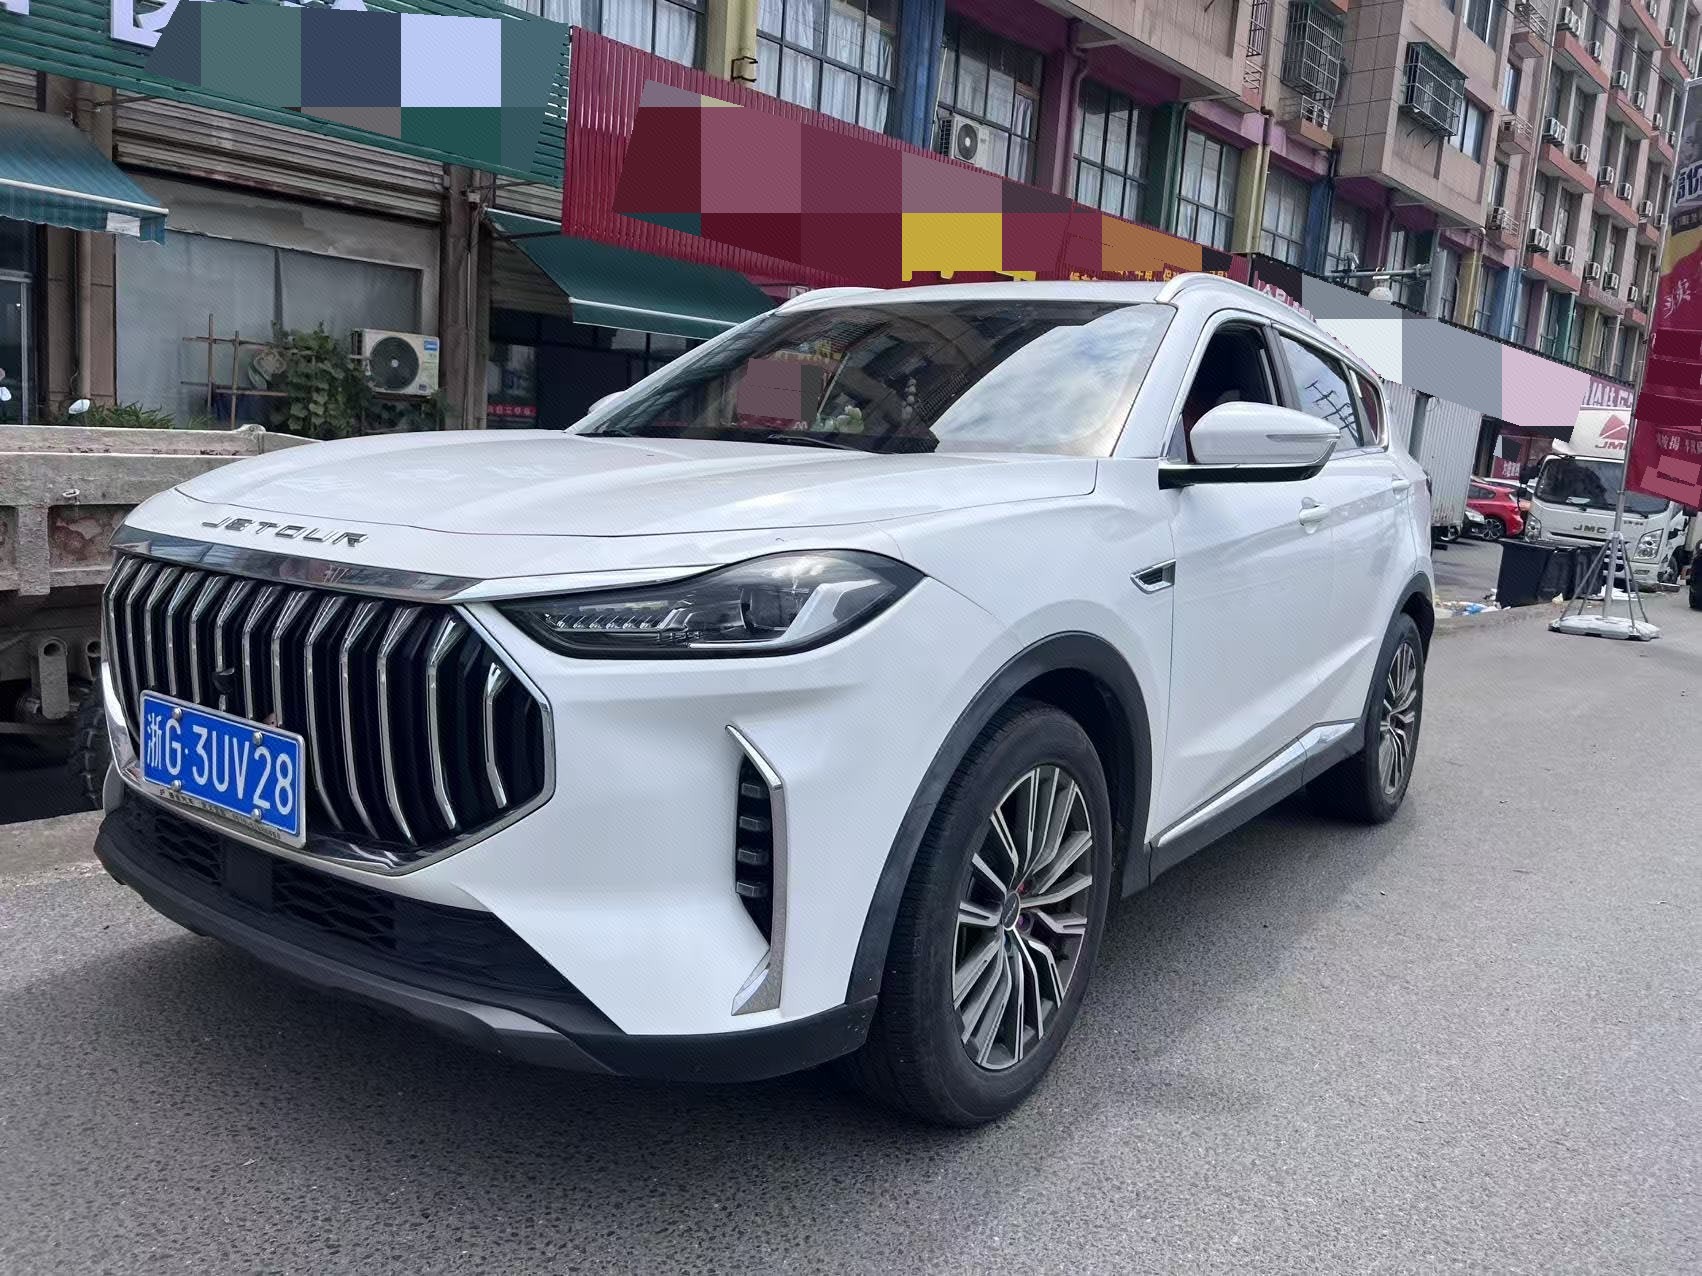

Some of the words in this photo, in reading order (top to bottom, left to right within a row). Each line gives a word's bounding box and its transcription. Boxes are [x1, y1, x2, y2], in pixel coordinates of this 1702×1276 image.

[1595, 441, 1627, 451] JM
[201, 516, 368, 548] JETOUR
[1573, 524, 1608, 534] JMC
